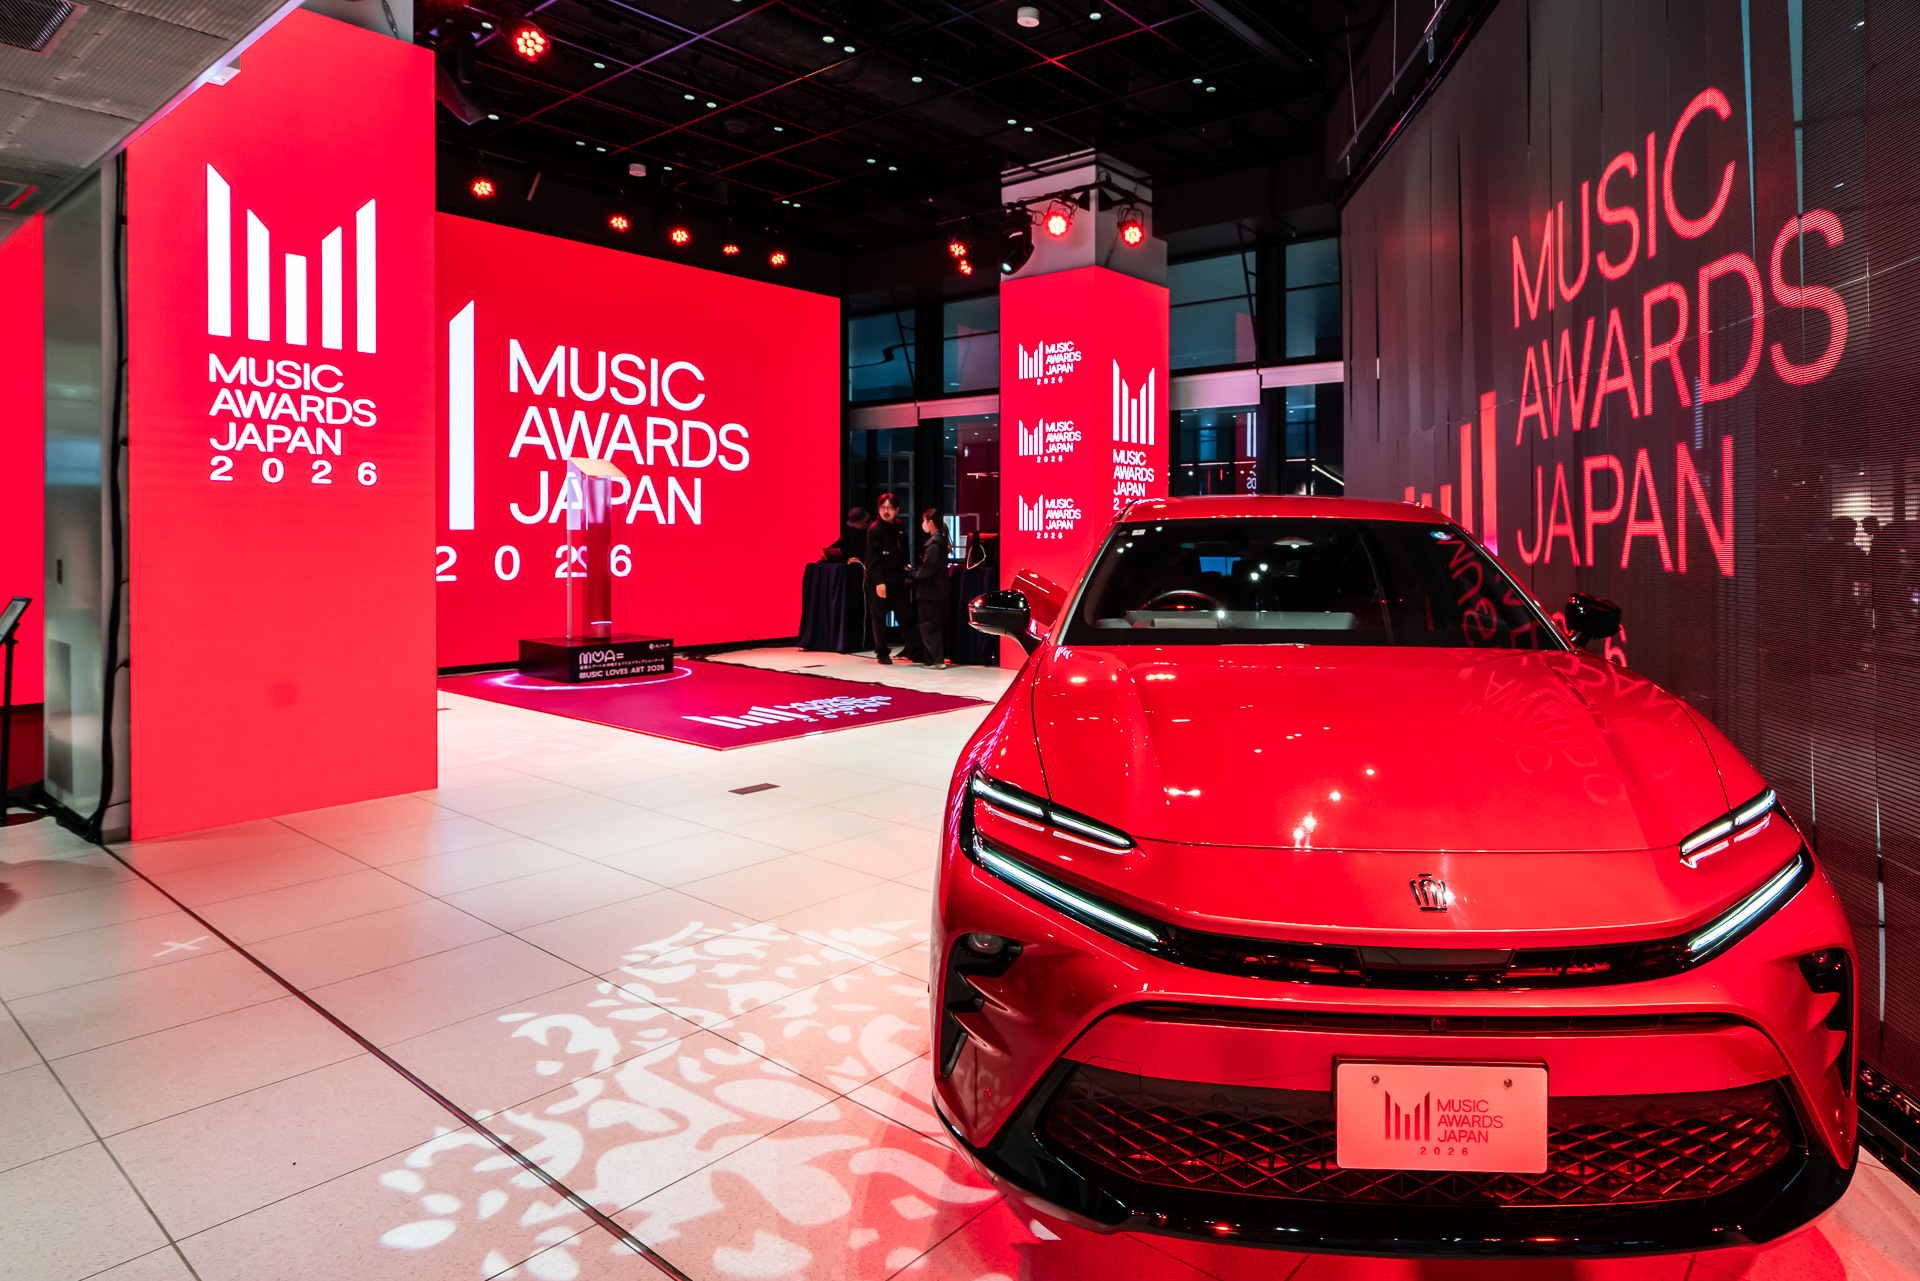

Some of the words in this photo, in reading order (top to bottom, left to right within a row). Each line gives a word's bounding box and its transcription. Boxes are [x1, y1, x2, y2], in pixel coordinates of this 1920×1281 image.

[1512, 87, 1735, 329] MUSIC
[1516, 209, 1848, 446] AWARDS
[1045, 341, 1074, 354] MUSIC
[1045, 351, 1082, 365] AWARDS
[209, 353, 344, 393] MUSIC
[510, 339, 706, 411] MUSIC
[1045, 363, 1074, 375] JAPAN
[209, 388, 378, 427] AWARDS
[1045, 421, 1074, 432] MUSIC
[209, 422, 342, 456] JAPAN
[509, 406, 750, 471] AWARDS
[1045, 431, 1082, 443] AWARDS
[1045, 442, 1074, 454] JAPAN
[1113, 449, 1146, 466] MUSIC
[1113, 465, 1154, 482] AWARDS
[1113, 481, 1146, 497] JAPAN
[1045, 498, 1074, 509] MUSIC
[1516, 435, 1734, 577] JAPAN
[1045, 509, 1082, 520] AWARDS
[1045, 520, 1074, 530] JAPAN
[579, 670, 604, 679] MUSIC
[605, 668, 628, 676] LOVES
[1437, 1099, 1489, 1113] MUSIC
[1437, 1114, 1504, 1129] AWARDS
[1437, 1129, 1489, 1144] JAPAN
